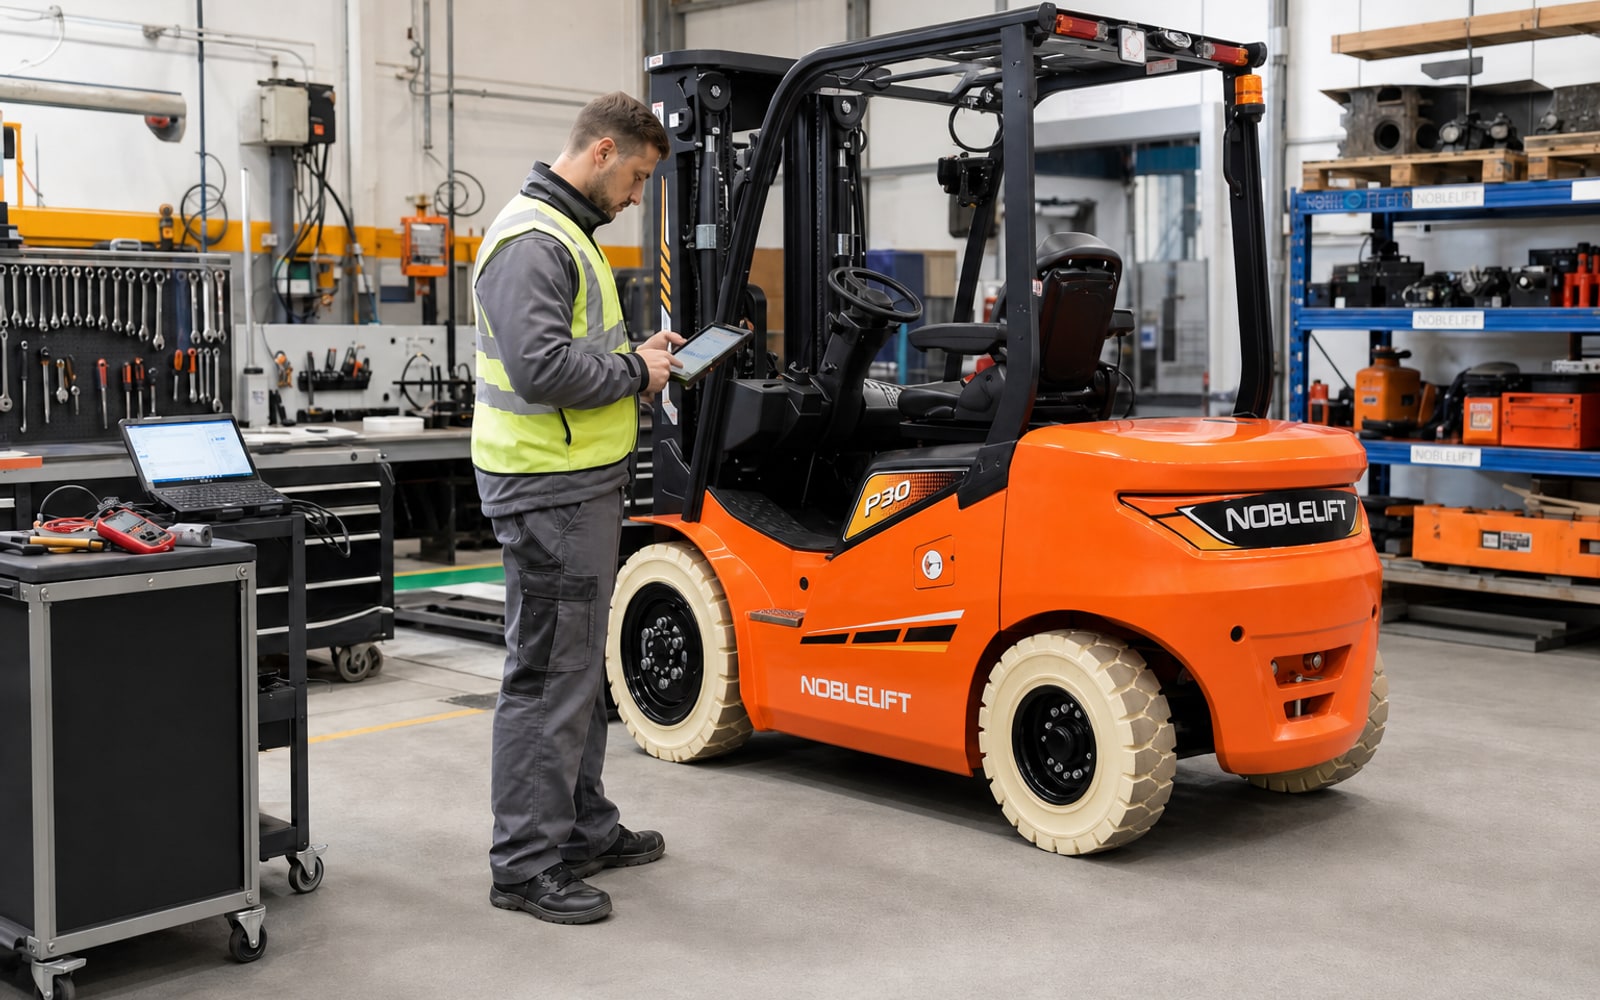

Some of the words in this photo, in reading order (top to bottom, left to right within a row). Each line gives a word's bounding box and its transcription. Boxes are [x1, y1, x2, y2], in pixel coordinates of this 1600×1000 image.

[1416, 190, 1478, 205] NOBLELIFT
[1417, 314, 1478, 326] NOBLELIFT
[1415, 448, 1475, 463] NOBLELIFT
[865, 480, 911, 517] P30
[1225, 499, 1346, 532] NOBLELIFT
[800, 675, 912, 713] NOBLELIFT
